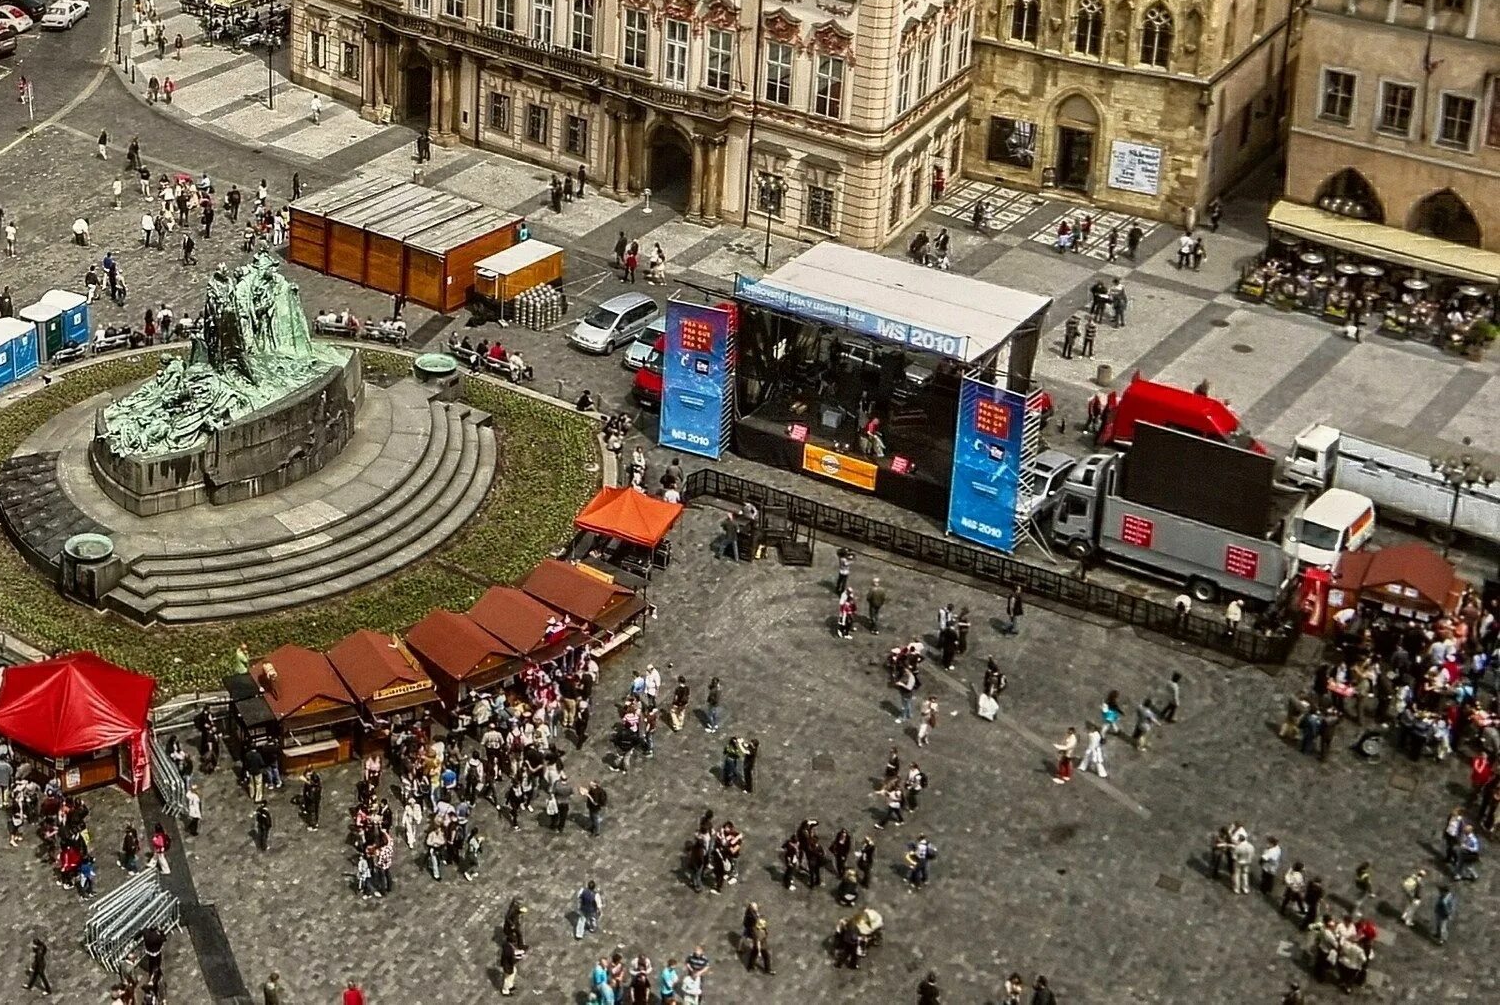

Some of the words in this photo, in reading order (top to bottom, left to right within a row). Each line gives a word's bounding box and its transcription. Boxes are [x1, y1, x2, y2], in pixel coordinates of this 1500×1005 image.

[877, 318, 906, 341] MS
[910, 329, 956, 355] 2010
[671, 428, 687, 441] MS
[687, 433, 709, 446] 2010
[961, 515, 978, 530] MS
[978, 522, 1002, 538] 2010
